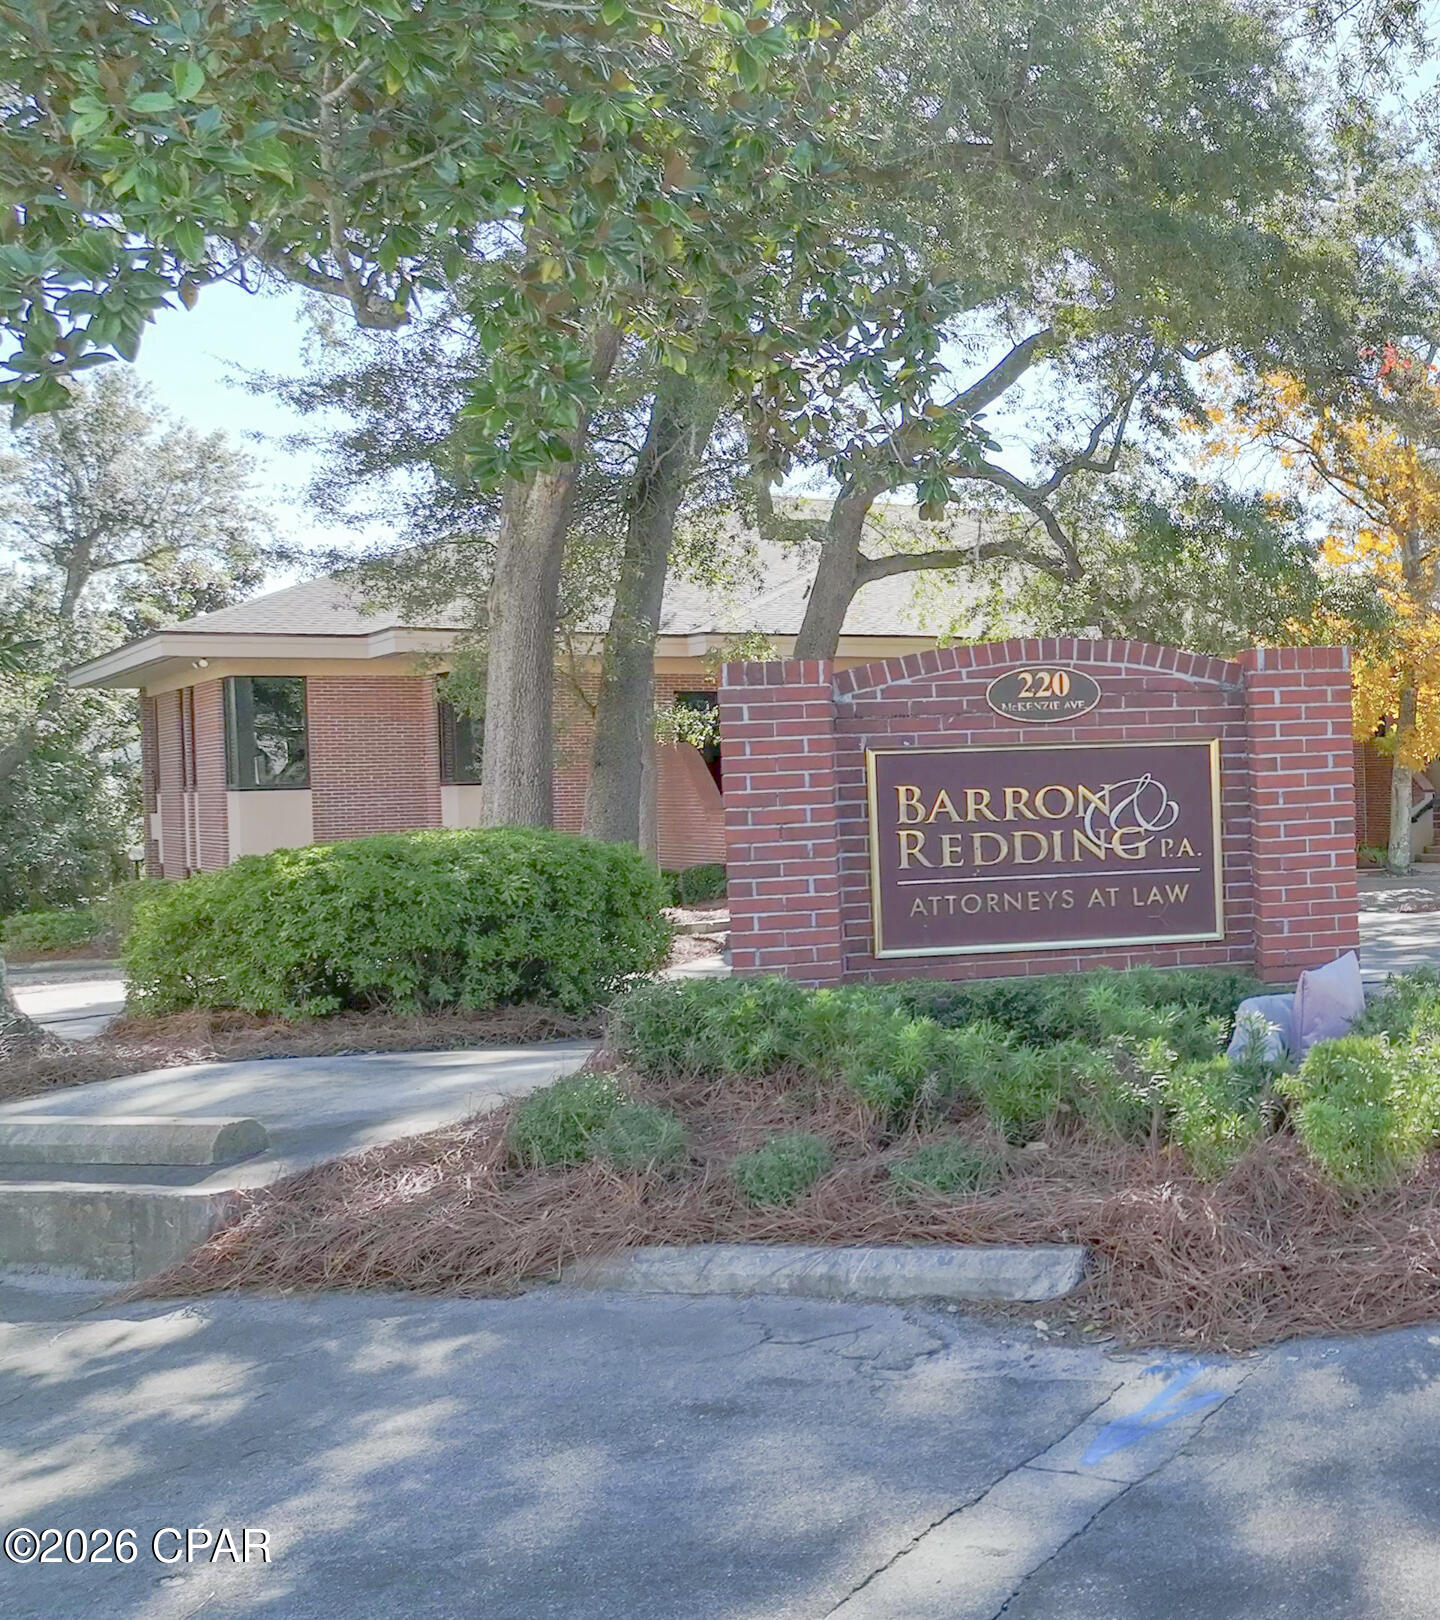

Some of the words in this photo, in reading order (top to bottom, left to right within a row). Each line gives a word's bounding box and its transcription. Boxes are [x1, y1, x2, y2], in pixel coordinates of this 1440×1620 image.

[1017, 670, 1070, 698] 220
[894, 784, 1113, 826] BARRON
[896, 826, 1148, 870] REDDING
[1160, 837, 1202, 859] P.A.
[909, 889, 1074, 918] ATTORNEYS
[1087, 887, 1119, 909] AT
[1132, 884, 1190, 907] LAW
